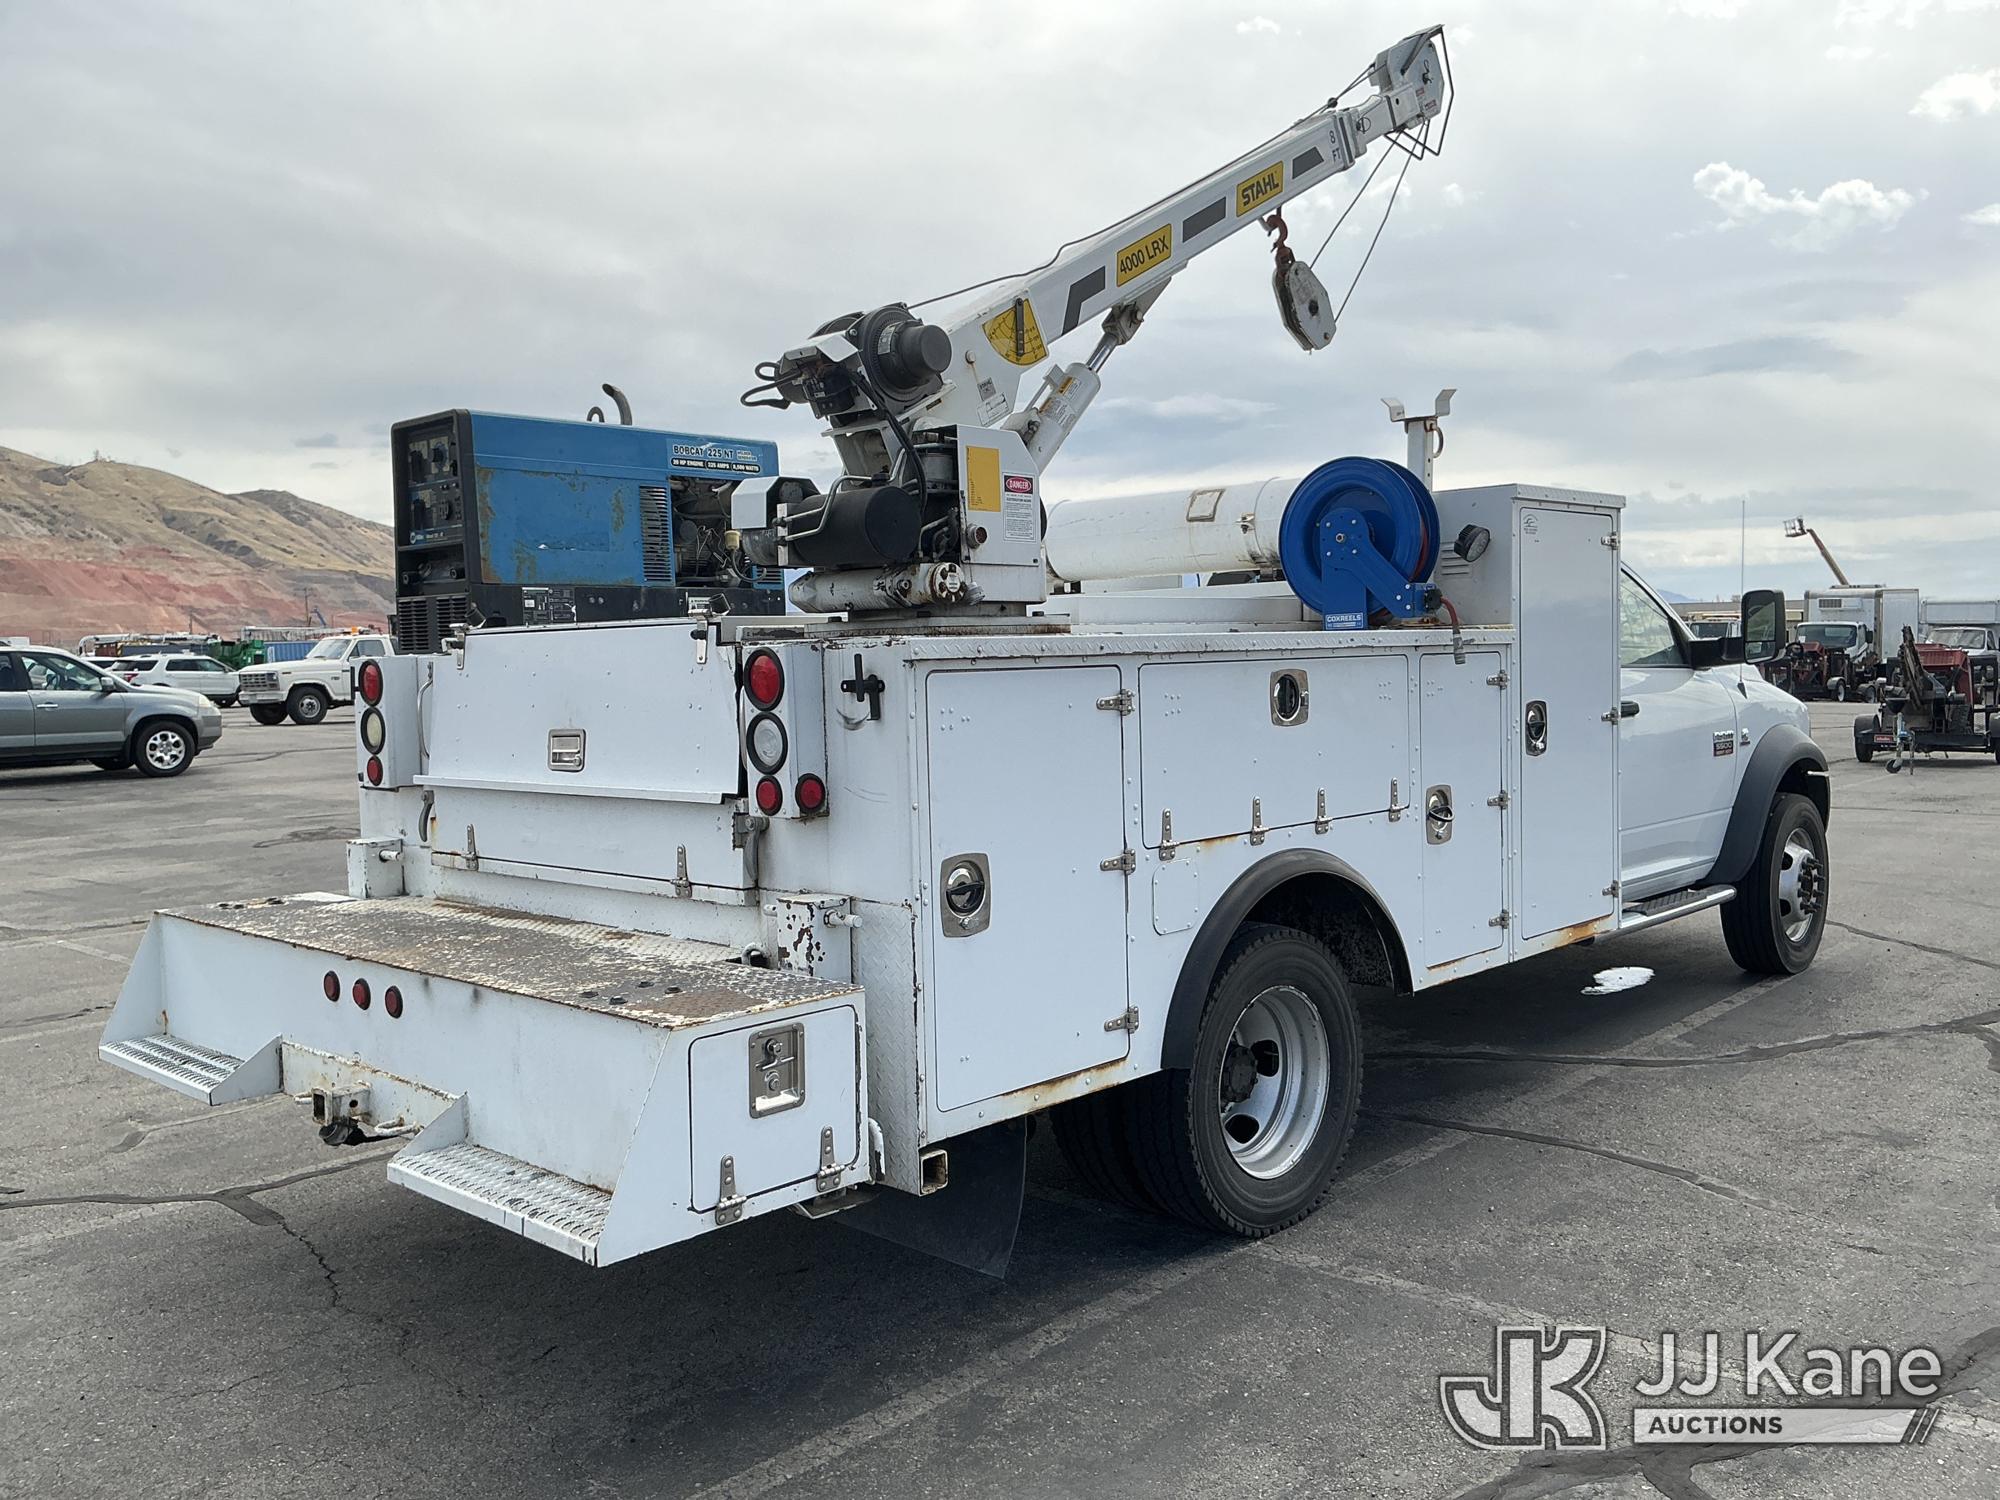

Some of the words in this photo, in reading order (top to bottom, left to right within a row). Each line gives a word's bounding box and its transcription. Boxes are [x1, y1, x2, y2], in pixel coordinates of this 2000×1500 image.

[1329, 130, 1336, 144] 8
[1331, 148, 1341, 162] FT
[1241, 172, 1280, 207] STAHL
[1119, 251, 1145, 274] 4000
[1145, 235, 1170, 260] LRX
[673, 445, 704, 456] BOBCAT
[707, 448, 722, 458] 225
[724, 449, 734, 459] NT
[1009, 480, 1029, 490] DANGER
[1326, 614, 1361, 623] COXREELS
